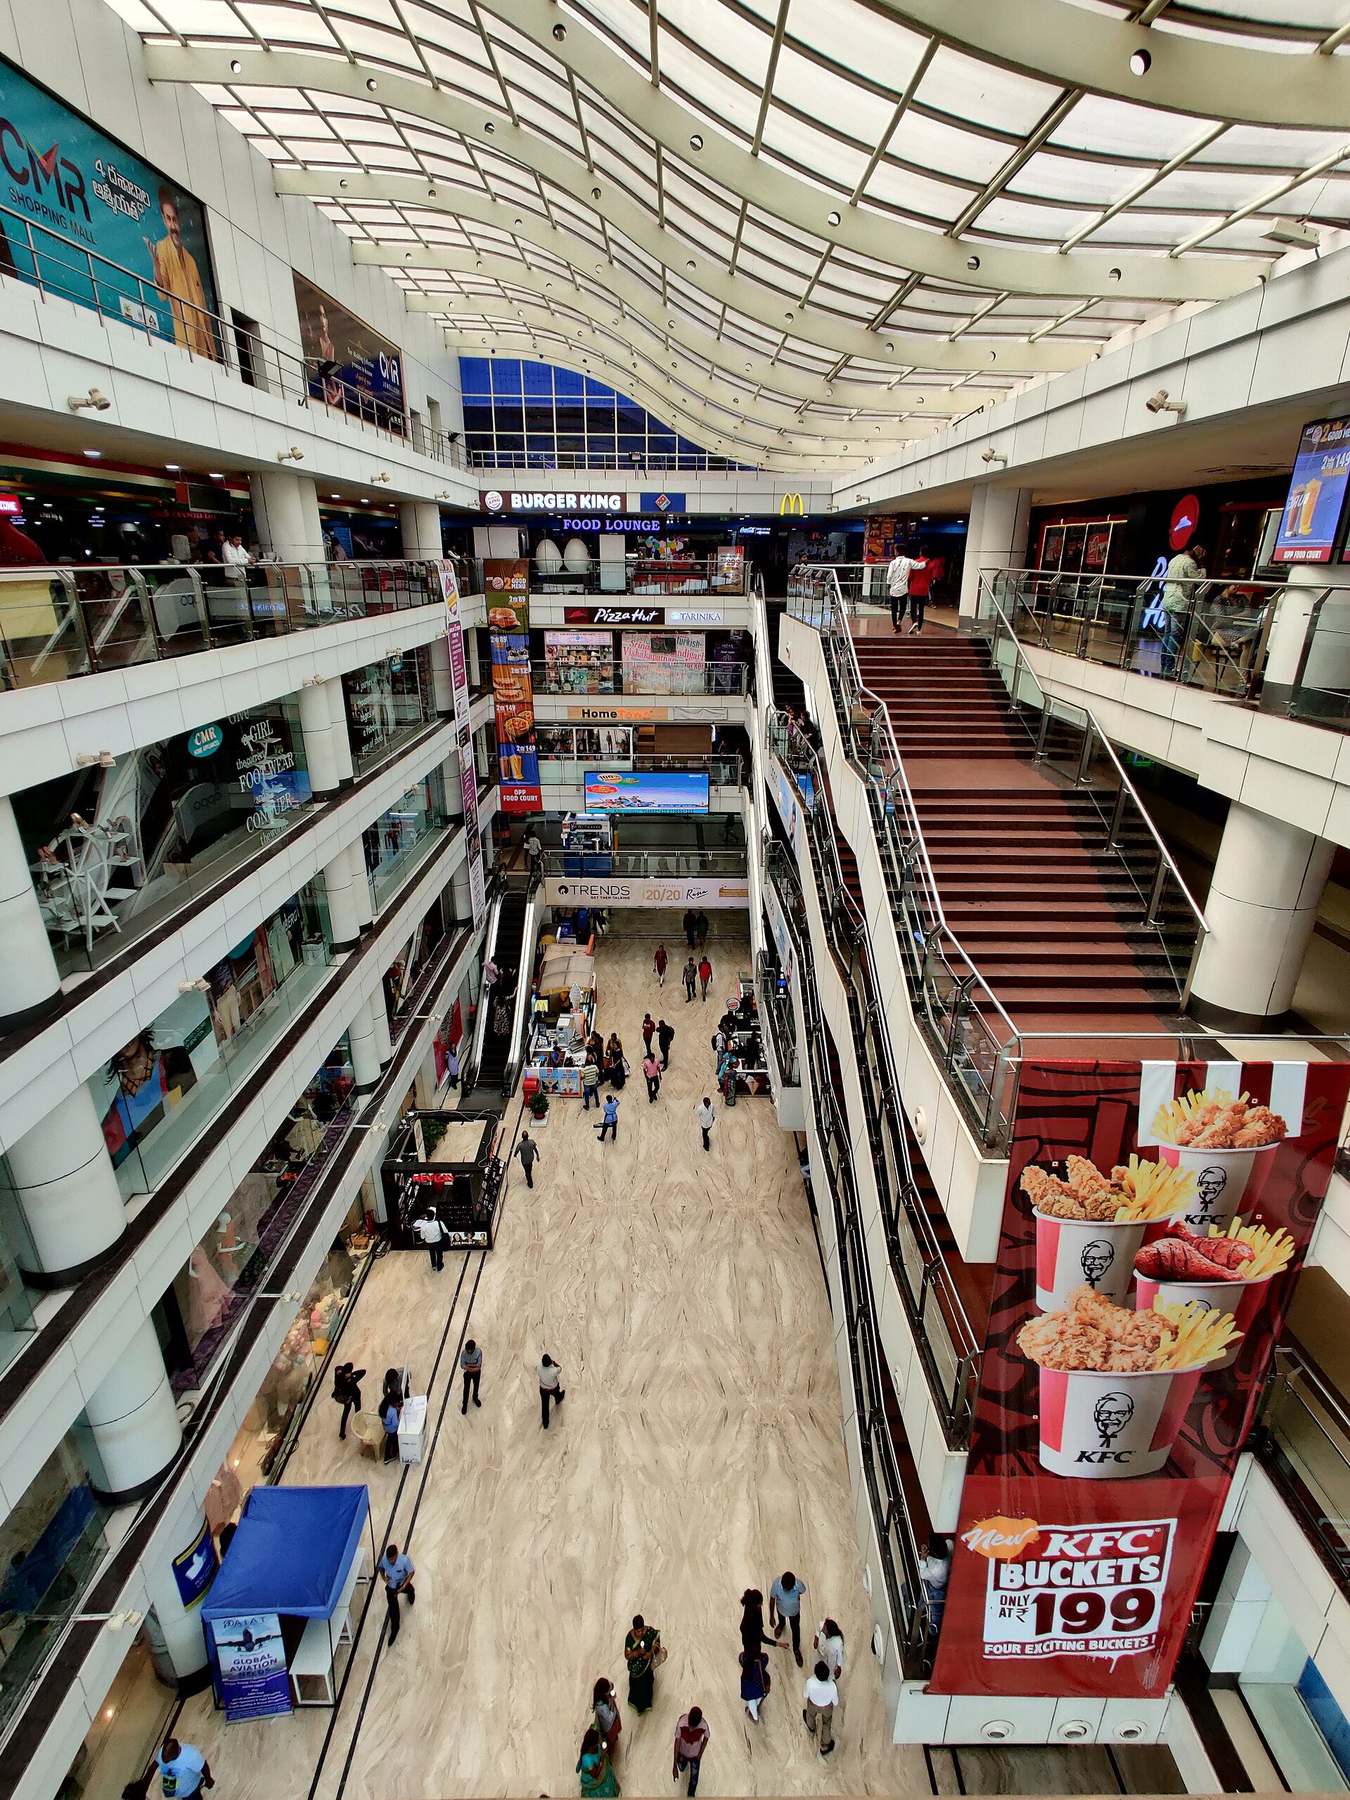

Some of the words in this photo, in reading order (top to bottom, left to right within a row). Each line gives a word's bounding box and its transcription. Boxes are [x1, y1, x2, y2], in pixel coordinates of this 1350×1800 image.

[0, 117, 92, 224] CMR
[8, 187, 67, 230] SHOPPING
[69, 219, 97, 245] MALL
[511, 493, 577, 509] BURGER
[580, 493, 621, 510] KING
[563, 519, 600, 530] FOOD
[605, 519, 660, 531] LOUNGE
[504, 577, 511, 590] 2
[593, 608, 631, 622] Pizza
[631, 608, 659, 622] Hut
[680, 612, 721, 621] TARINIKA
[581, 708, 618, 719] Home
[194, 726, 217, 746] CMR
[249, 720, 274, 743] GIRL
[246, 792, 292, 833] CONUER
[570, 885, 630, 896] TRENDS
[646, 889, 681, 901] 20/20
[1184, 1214, 1228, 1225] KFC
[1073, 1450, 1134, 1464] KFC
[961, 1525, 1038, 1552] New
[1042, 1528, 1157, 1557] KFC
[1000, 1556, 1161, 1590] BUCKETS
[1000, 1594, 1031, 1606] ONLY
[998, 1607, 1013, 1619] AT
[1031, 1588, 1156, 1636] 199
[984, 1643, 1022, 1656] FOUR
[1024, 1639, 1086, 1655] EXCITING
[1088, 1637, 1149, 1651] BUCKETS
[230, 1657, 278, 1673] AVIATION
[233, 1653, 273, 1666] GLOBAL
